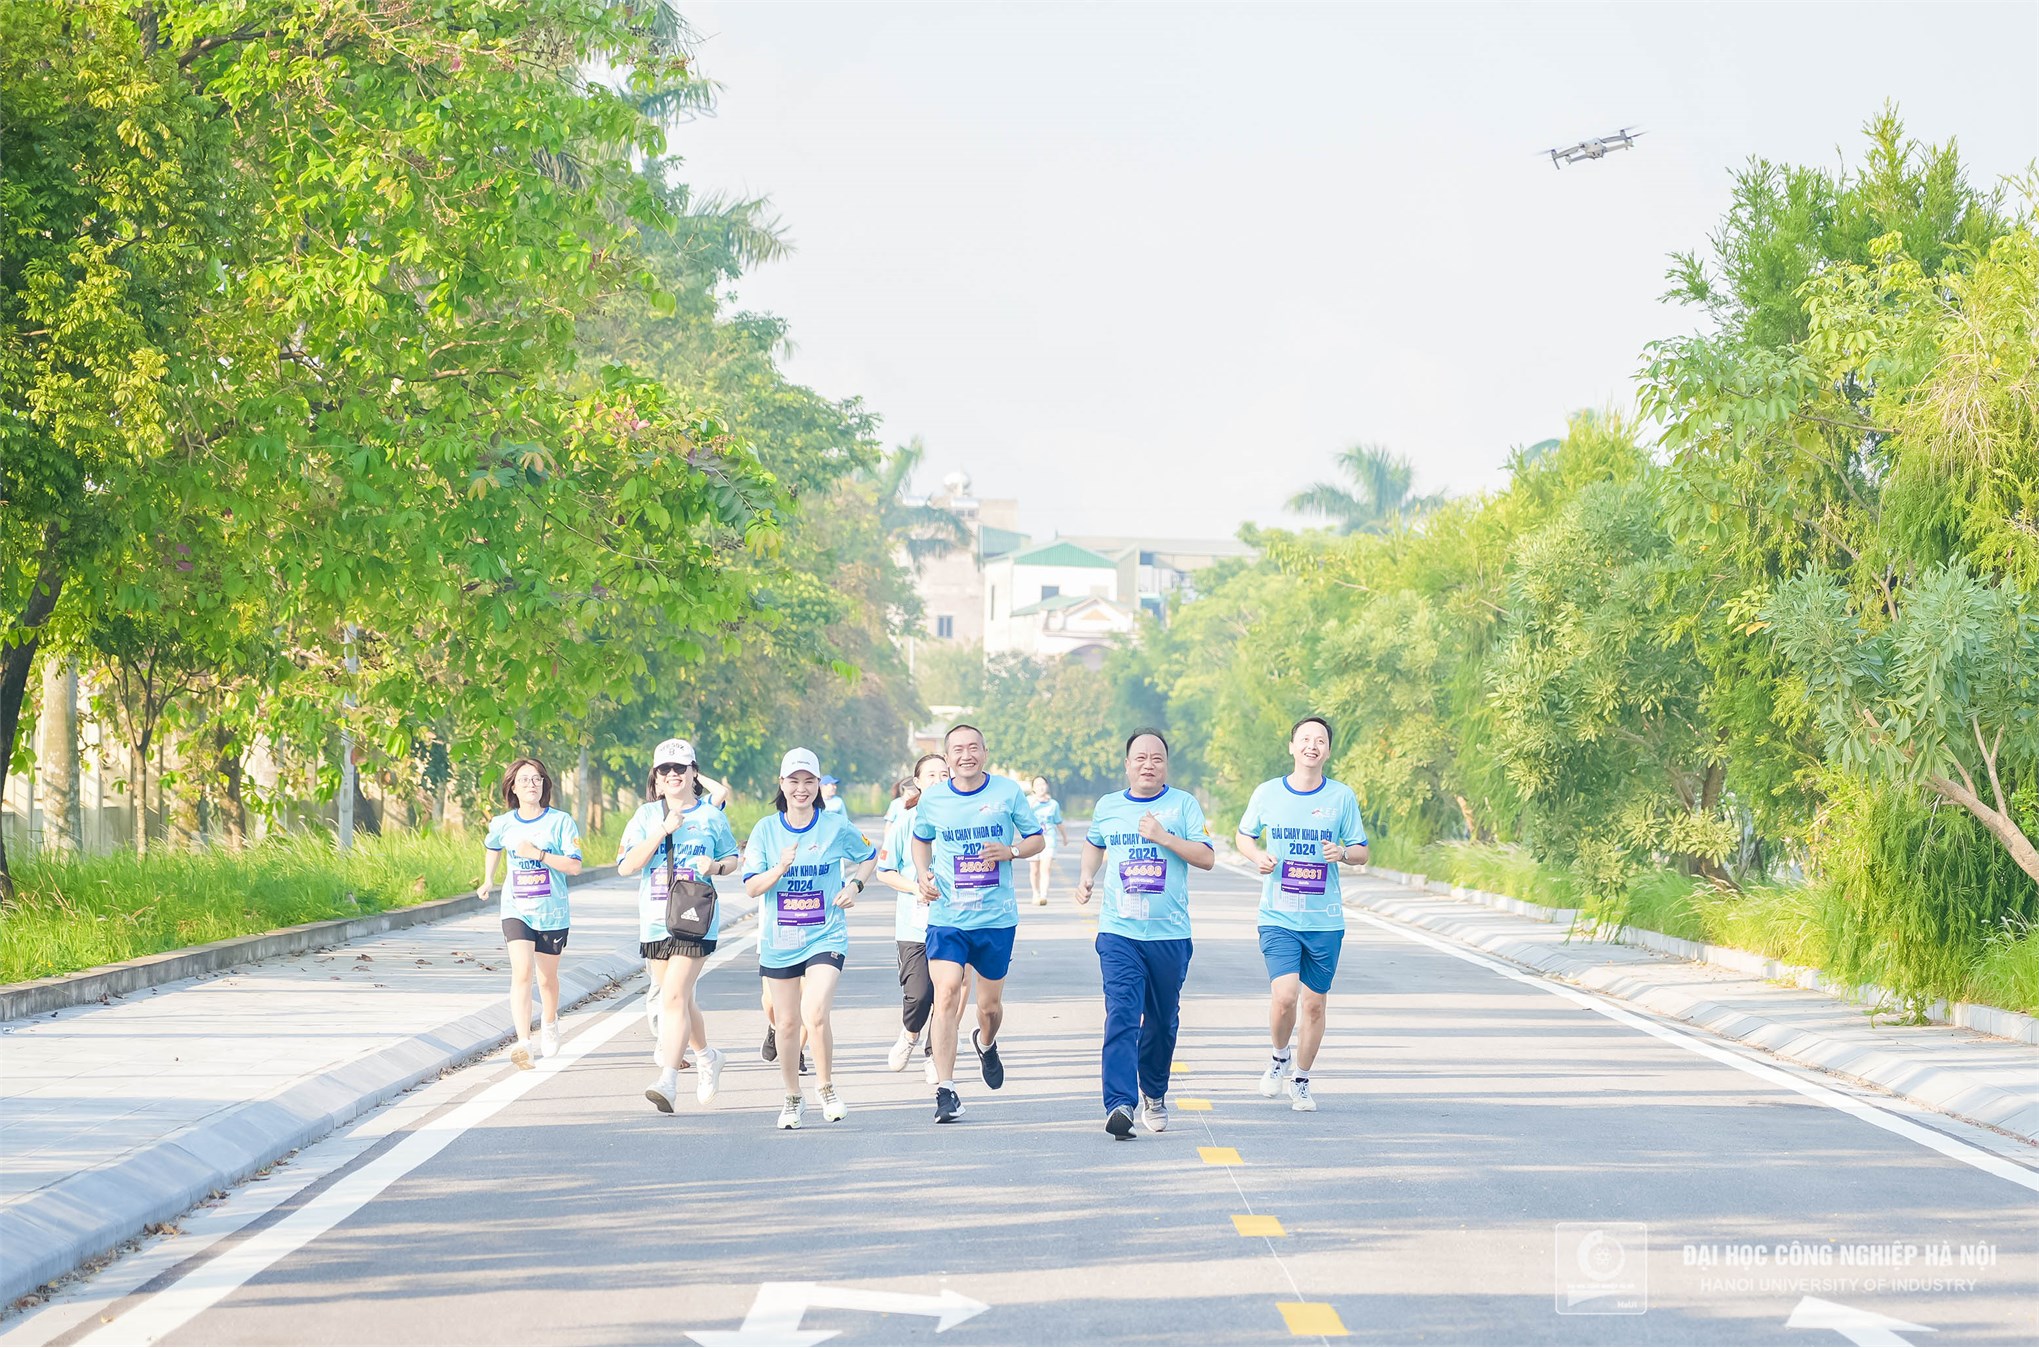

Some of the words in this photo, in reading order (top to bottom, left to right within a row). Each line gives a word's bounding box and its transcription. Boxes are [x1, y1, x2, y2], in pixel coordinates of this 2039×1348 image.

[973, 826, 989, 839] KHOA
[1302, 829, 1319, 841] KHOA
[1128, 847, 1158, 860] 2024
[1289, 843, 1316, 855] 2024
[519, 860, 542, 869] 2024
[799, 865, 817, 876] KHOA
[960, 861, 995, 873] 25029
[1288, 867, 1322, 879] 25031
[788, 880, 813, 891] 2024
[783, 898, 820, 910] 25028
